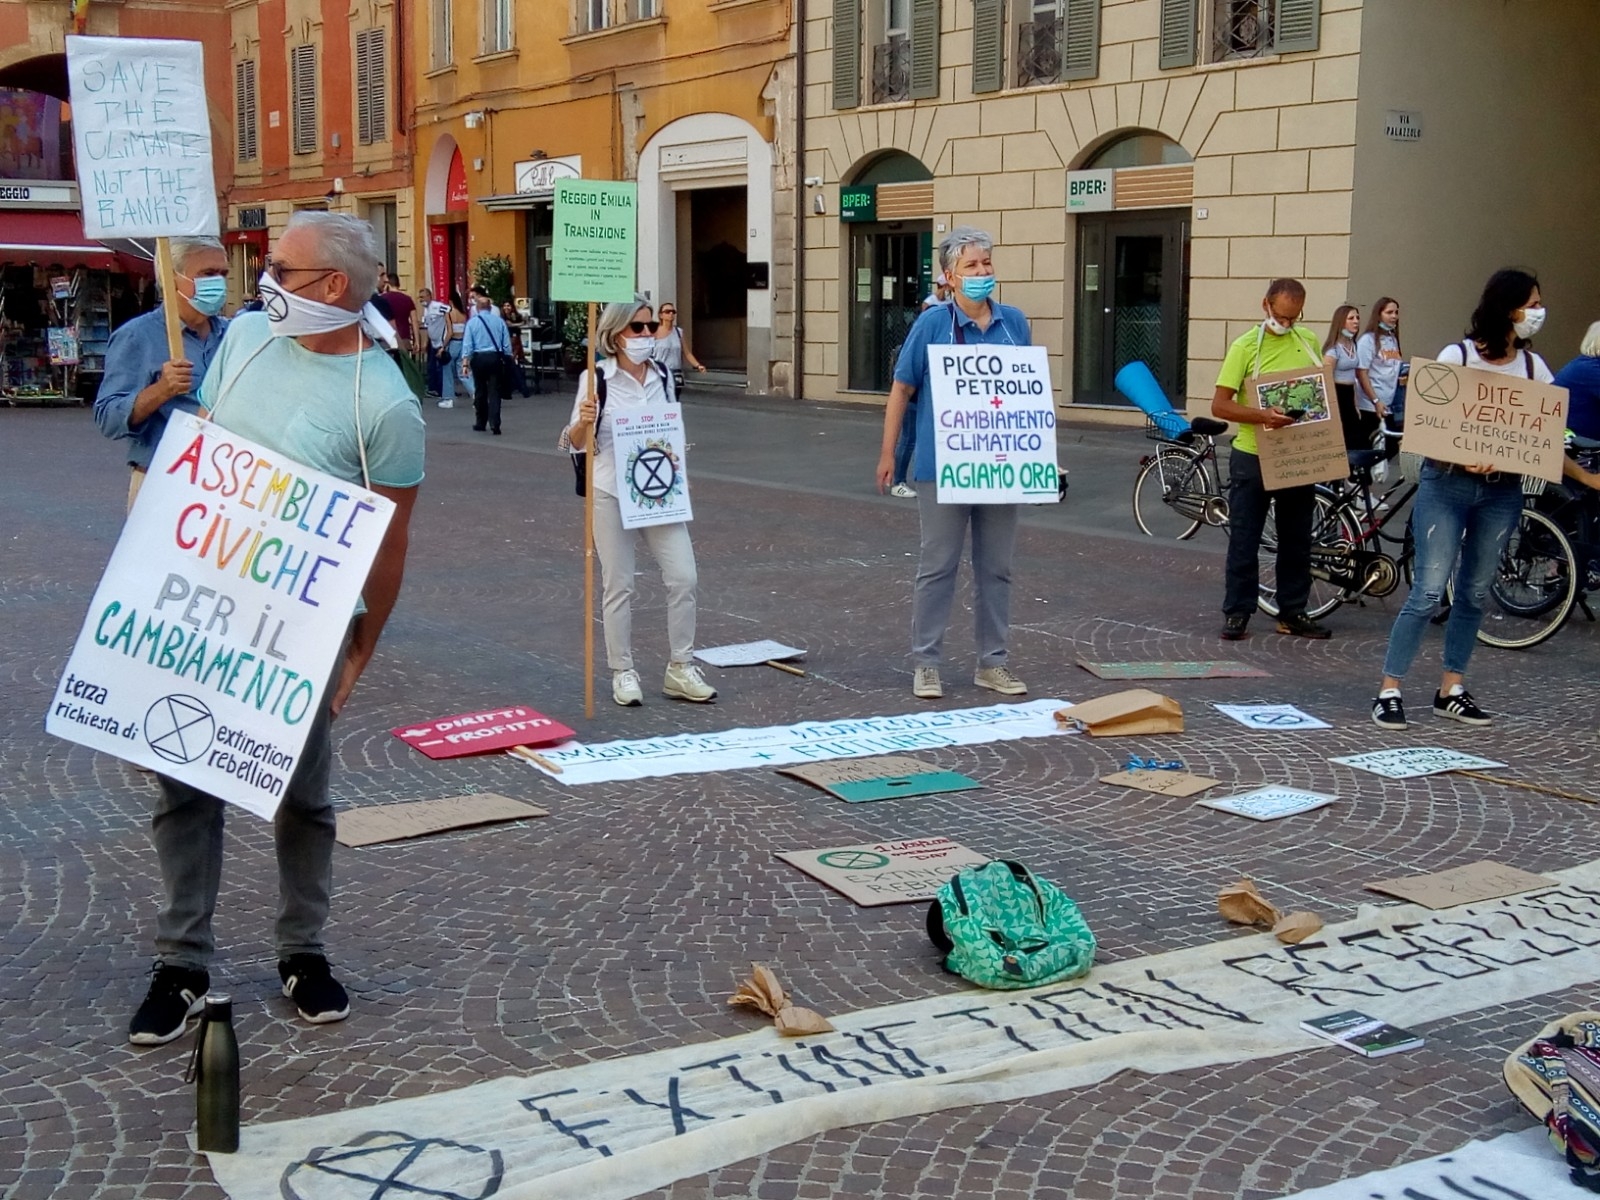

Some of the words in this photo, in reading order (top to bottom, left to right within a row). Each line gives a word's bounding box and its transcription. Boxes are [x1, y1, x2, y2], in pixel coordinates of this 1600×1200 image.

[82, 60, 179, 93] SAVE
[95, 100, 177, 125] THE
[1399, 115, 1410, 124] VIA
[85, 130, 210, 161] CLIMATE
[0, 187, 30, 200] EGGIO
[93, 168, 131, 194] NOT
[141, 167, 197, 194] THE
[560, 189, 597, 205] REGGIO
[601, 192, 632, 207] EMILIA
[98, 197, 190, 229] BANKS
[590, 209, 601, 220] IN
[564, 223, 627, 240] TRANSIZIONE
[943, 355, 1003, 376] PICCO
[1012, 363, 1036, 374] DEL
[955, 379, 1043, 396] PETROLIO
[1477, 383, 1524, 407] DITE
[1540, 397, 1563, 417] LA
[641, 415, 654, 423] STOP
[664, 413, 677, 421] STOP
[940, 410, 1056, 430] CAMBIAMENTO
[946, 433, 1042, 452] CLIMATICO
[1460, 421, 1551, 450] EMERGENZA
[1452, 436, 1541, 465] CLIMATICA
[940, 462, 1015, 489] AGIAMO
[1019, 462, 1058, 489] ORA
[166, 433, 376, 549] ASSEMBLEE
[154, 573, 236, 636] PER
[93, 600, 314, 726] CAMBIAMENTO
[64, 672, 109, 705] terza
[55, 700, 119, 737] richiesta
[122, 720, 139, 741] di
[436, 709, 527, 732] DIRITTI
[444, 718, 552, 744] PROFITTI
[216, 724, 293, 772] extinction
[790, 731, 957, 760] FUTURO
[207, 749, 284, 797] rebellion
[866, 878, 951, 894] REBEL
